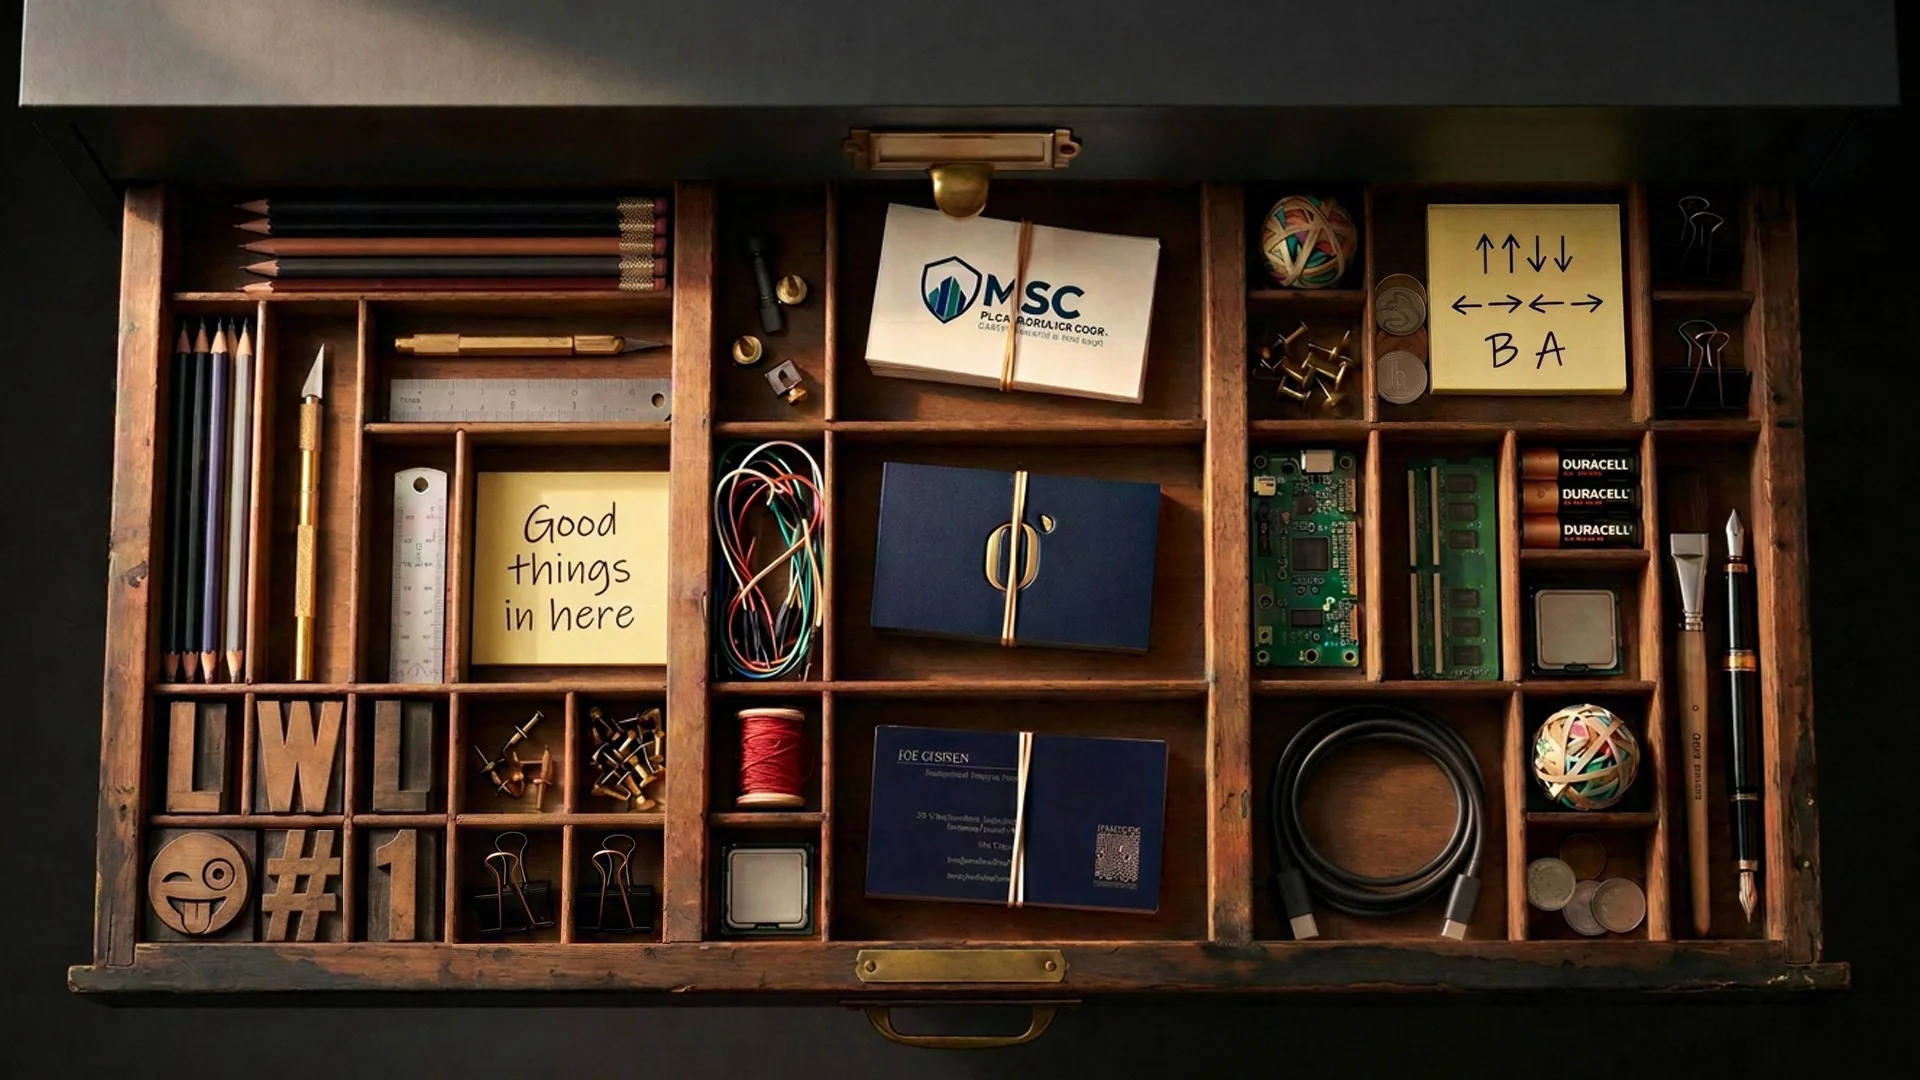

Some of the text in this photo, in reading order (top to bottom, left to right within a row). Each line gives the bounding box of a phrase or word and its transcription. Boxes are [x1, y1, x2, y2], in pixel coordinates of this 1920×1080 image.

[983, 273, 1085, 320] MSC
[1484, 331, 1566, 369] B A
[1562, 488, 1630, 500] DURACELL
[524, 501, 616, 543] Good
[1563, 524, 1632, 536] DURACELL
[507, 552, 631, 596] things
[505, 598, 635, 631] in here
[166, 700, 430, 812] L W L
[376, 829, 417, 941] 1
